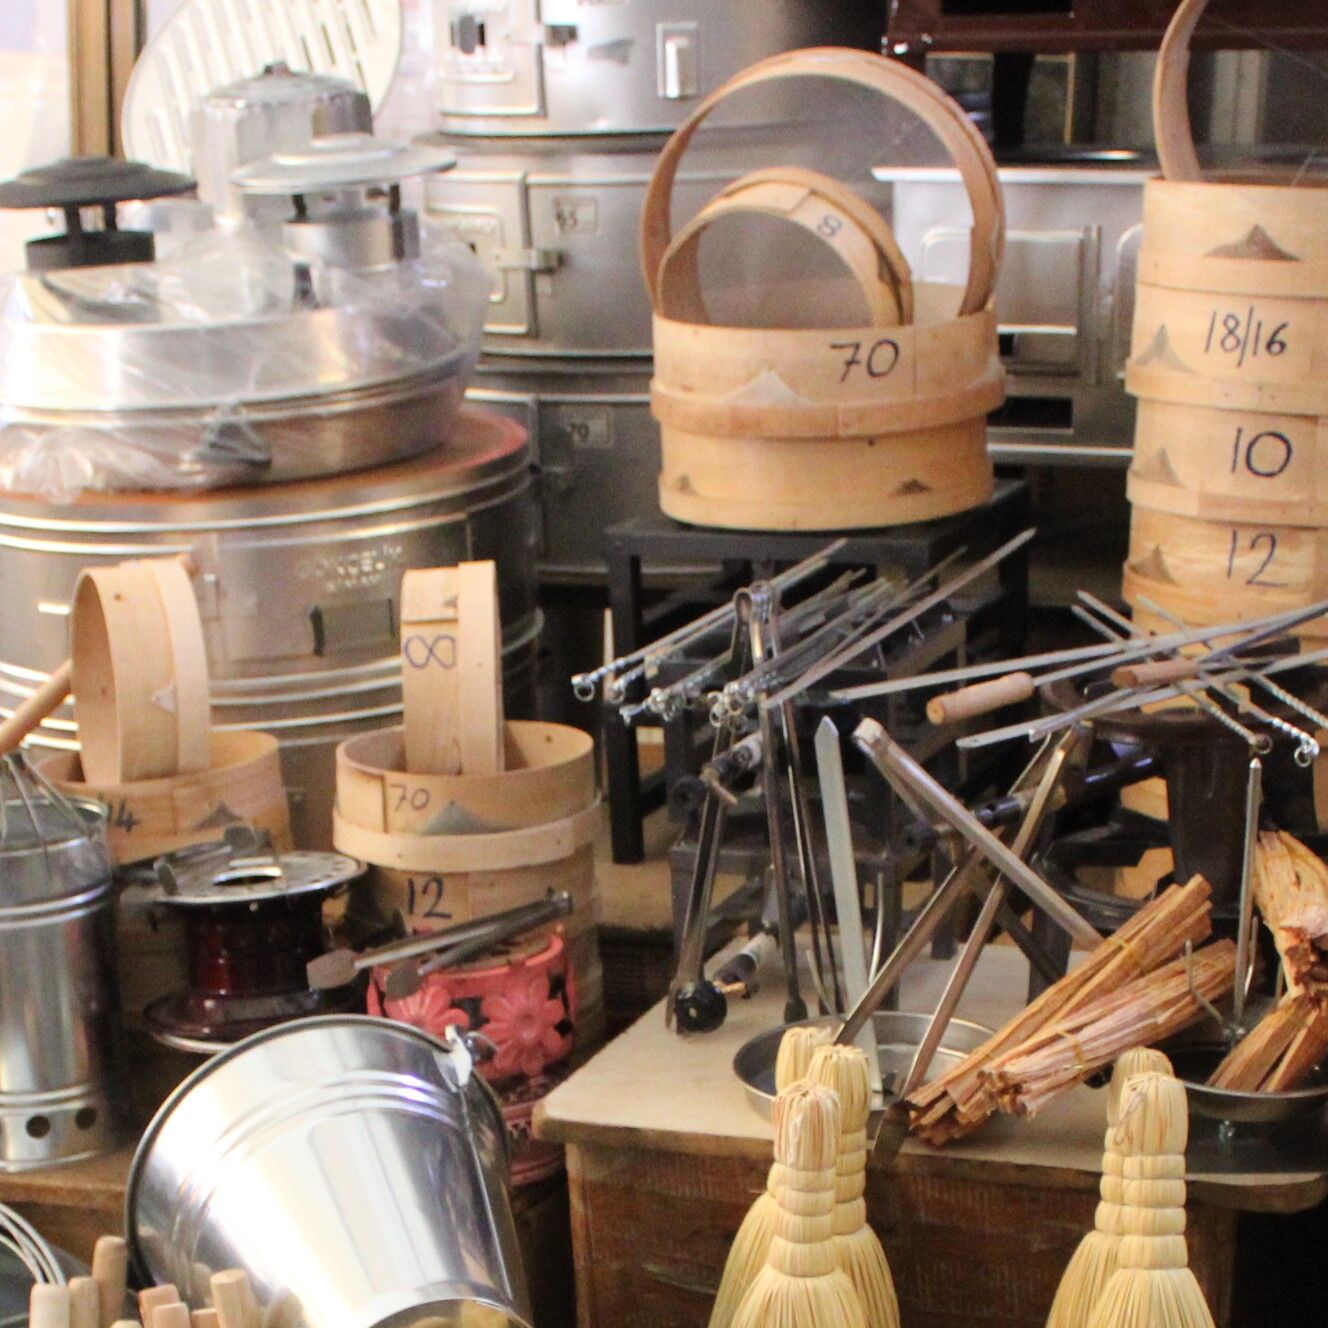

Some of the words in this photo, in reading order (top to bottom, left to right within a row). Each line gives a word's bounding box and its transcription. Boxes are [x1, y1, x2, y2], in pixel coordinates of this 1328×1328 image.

[829, 338, 900, 382] 70
[1204, 305, 1290, 368] 18/16
[1231, 426, 1294, 478] 10
[1227, 528, 1289, 588] 12
[389, 783, 430, 812] 70
[407, 876, 452, 919] 12
